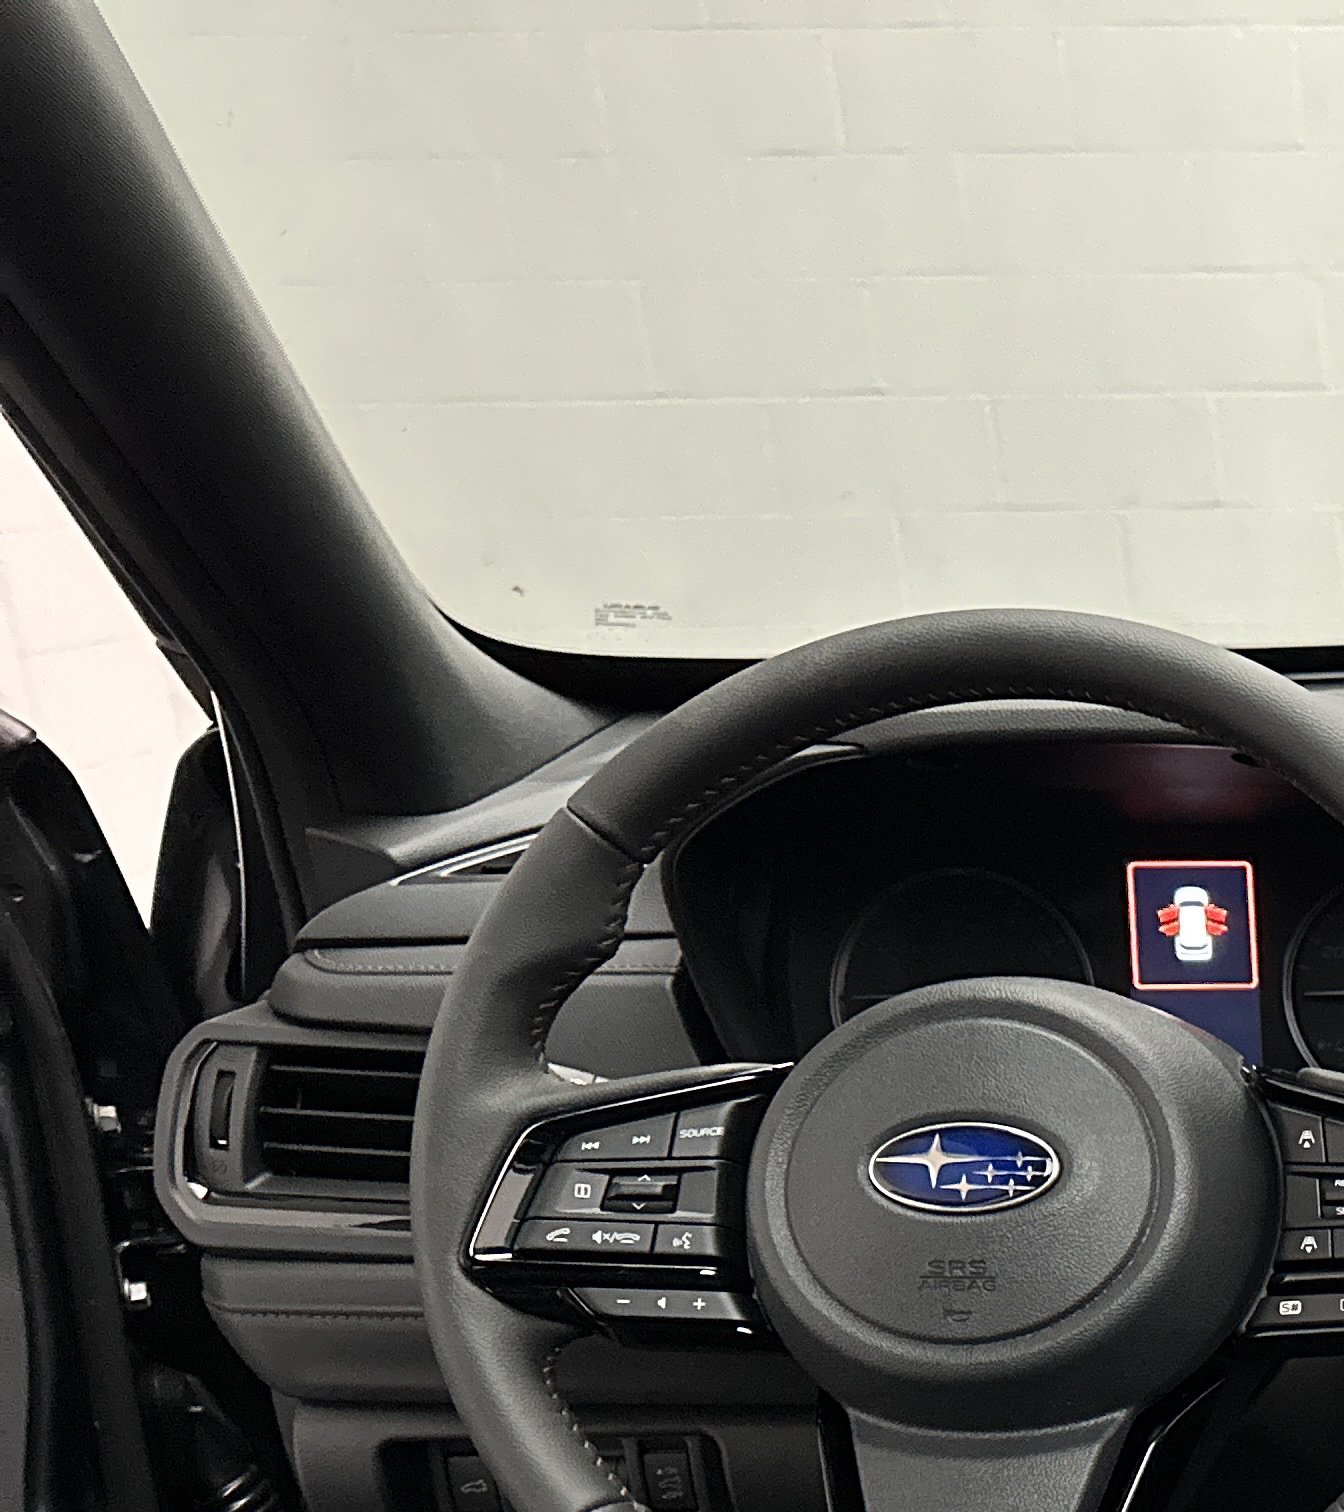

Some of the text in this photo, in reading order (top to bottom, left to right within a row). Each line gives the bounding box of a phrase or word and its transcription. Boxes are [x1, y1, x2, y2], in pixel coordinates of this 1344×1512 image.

[680, 1126, 725, 1139] SOURCE
[927, 1259, 987, 1276] SRS
[918, 1279, 997, 1293] AIRBAG
